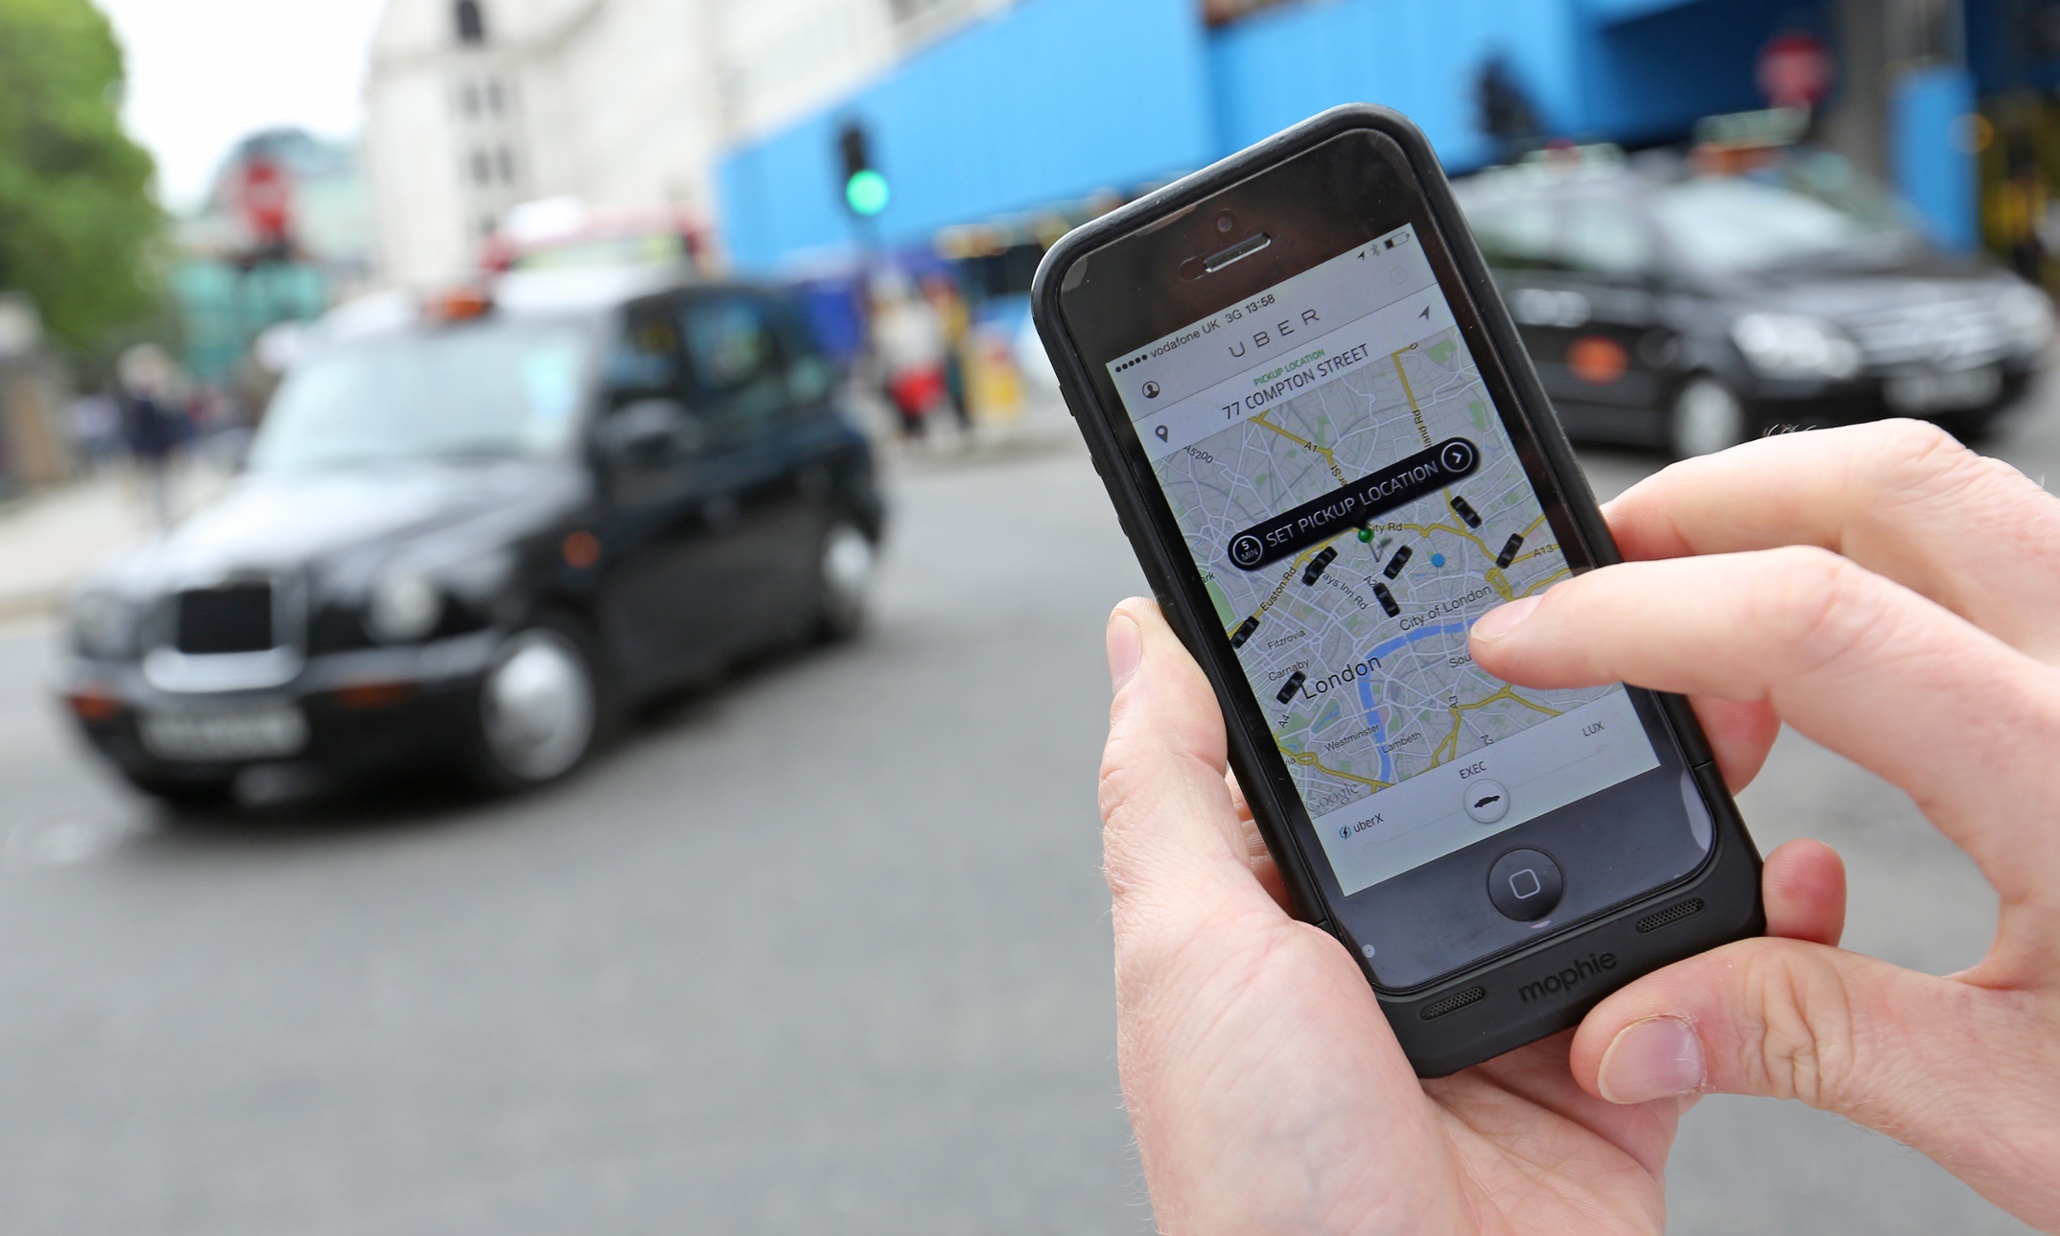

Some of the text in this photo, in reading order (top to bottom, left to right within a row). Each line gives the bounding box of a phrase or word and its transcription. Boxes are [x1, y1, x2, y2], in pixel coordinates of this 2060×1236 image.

[1150, 293, 1276, 358] vodafone UK 3G 13:58
[1228, 308, 1321, 358] UBER
[1253, 349, 1326, 387] PICKUP LOCATION
[1222, 343, 1370, 419] 77 COMPTON STREET
[1412, 408, 1424, 425] Rd
[1183, 444, 1214, 464] A5200
[1303, 441, 1318, 453] A1
[1266, 460, 1439, 547] SET PICKUP LOCATION
[1388, 522, 1403, 532] Rd
[1240, 547, 1259, 562] MIN
[1241, 540, 1250, 550] 5
[1533, 544, 1555, 558] A13
[1259, 566, 1298, 611] Euston Rd
[1338, 583, 1355, 599] Inn
[1353, 594, 1368, 610] Rd
[1399, 584, 1493, 632] City of London
[1267, 629, 1306, 650] Fitzrovia
[1268, 658, 1311, 682] Carnaby
[1300, 656, 1382, 699] London
[1448, 695, 1459, 709] A3
[1278, 713, 1291, 729] A4
[1581, 720, 1605, 737] LUX
[1324, 723, 1380, 752] Westminster
[1381, 731, 1422, 754] Lambeth
[1458, 760, 1487, 780] EXEC
[1305, 783, 1360, 812] Google
[1353, 813, 1384, 834] uberX
[1518, 952, 1617, 1003] mophie
